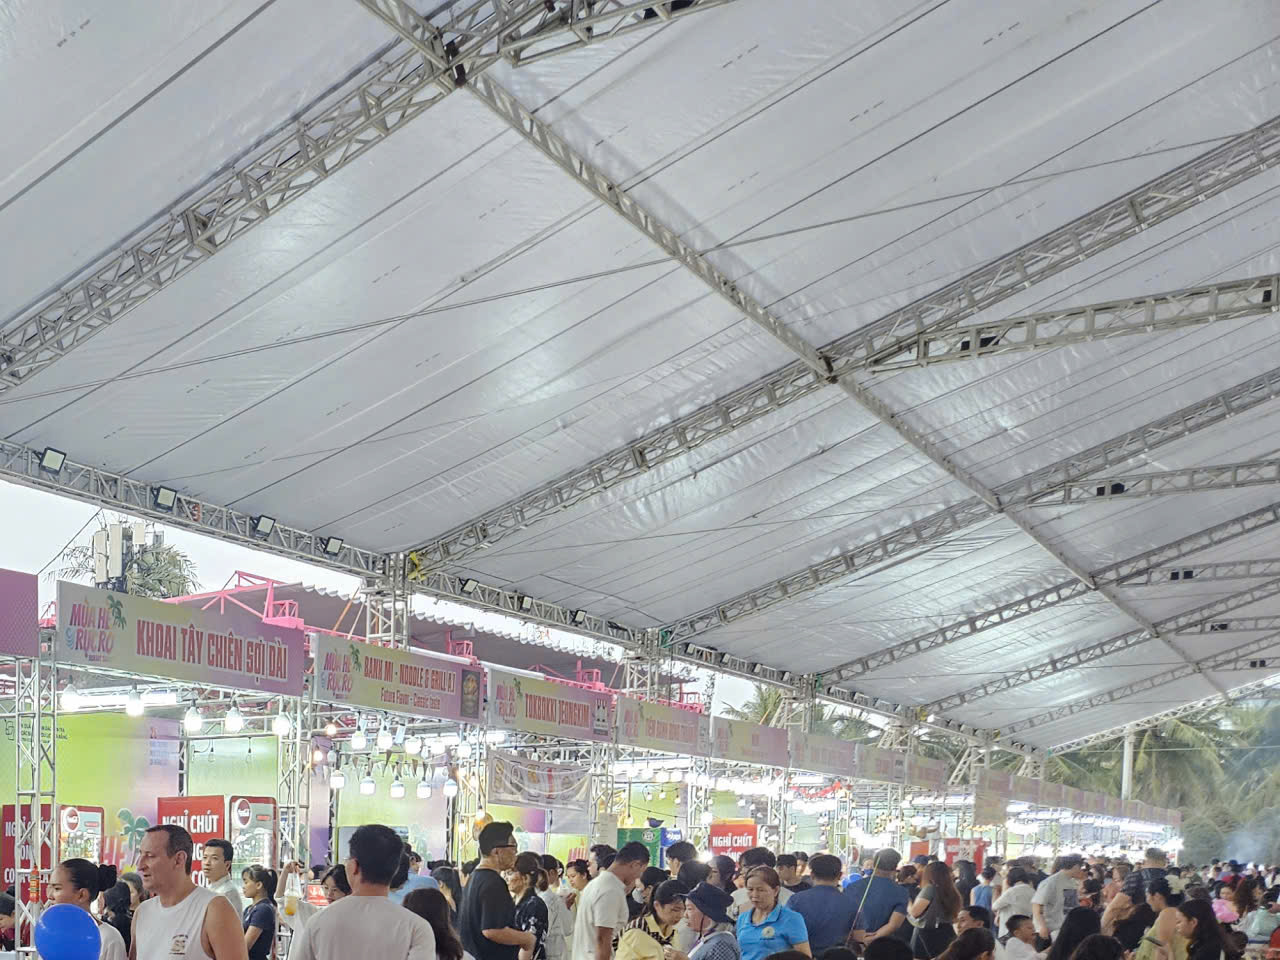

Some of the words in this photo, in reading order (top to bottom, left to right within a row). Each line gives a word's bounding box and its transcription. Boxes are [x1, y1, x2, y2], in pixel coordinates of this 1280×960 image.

[136, 619, 177, 661] KHOAI
[181, 623, 204, 665] TÂY
[207, 631, 243, 672] CHIÊN
[246, 639, 266, 682] SỢI
[268, 640, 287, 679] DÀI
[189, 809, 219, 833] CHÚT
[712, 832, 732, 847] NGHỈ
[732, 832, 753, 847] CHÚT
